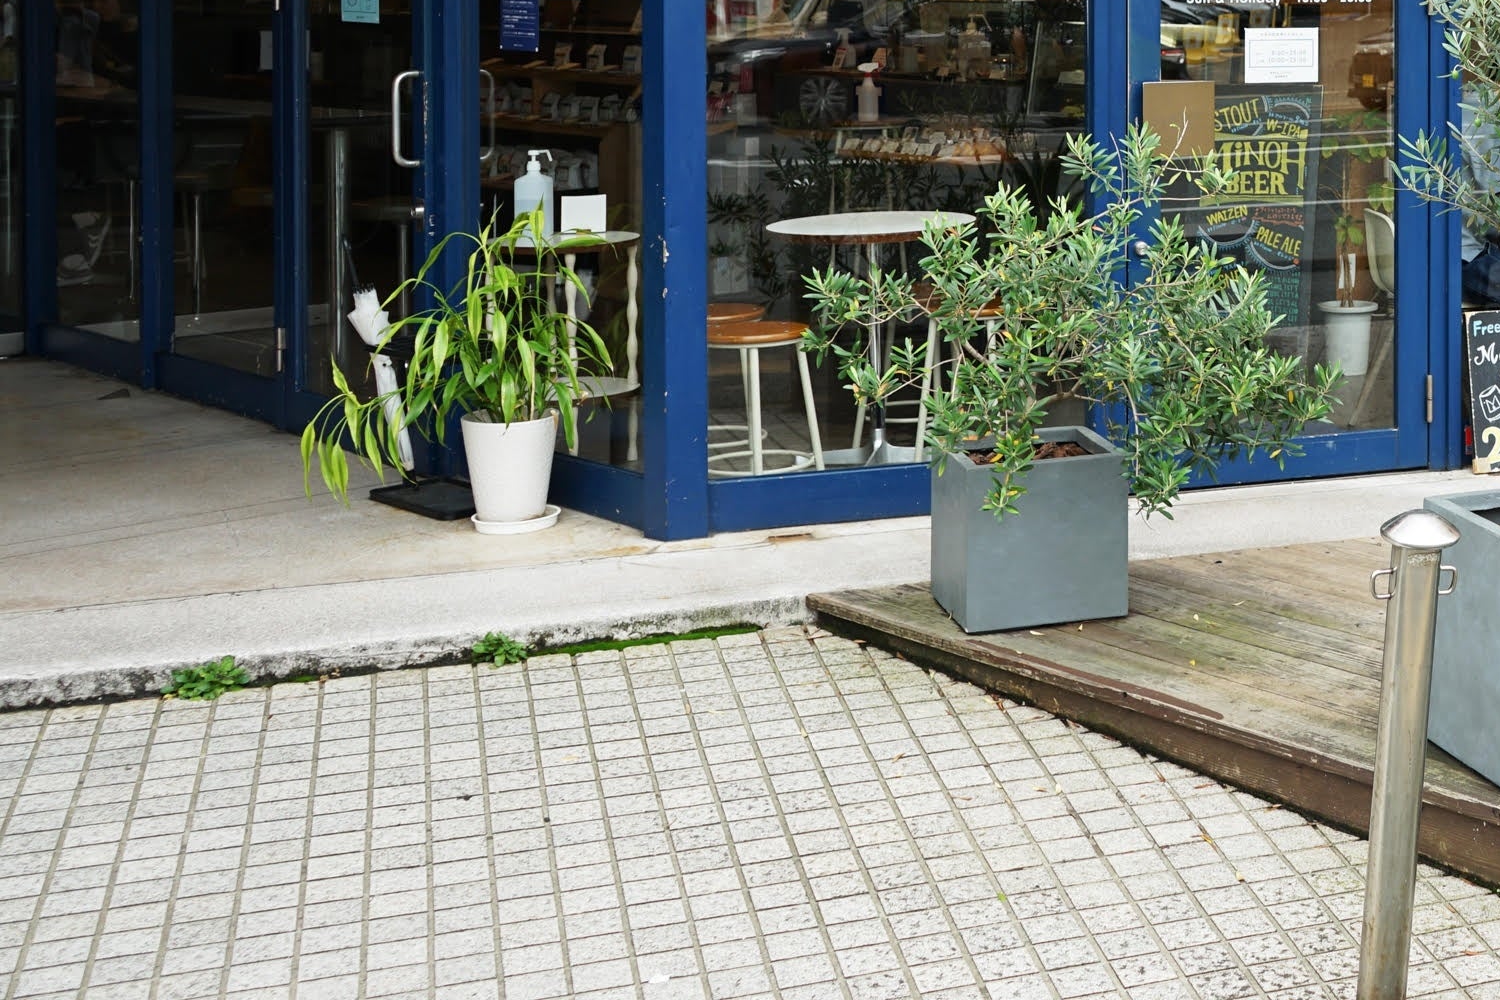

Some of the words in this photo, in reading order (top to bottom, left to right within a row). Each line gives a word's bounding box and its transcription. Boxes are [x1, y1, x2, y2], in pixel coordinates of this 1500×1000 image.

[1214, 98, 1260, 132] STOUT
[1266, 119, 1301, 138] W-IPA
[1225, 171, 1288, 195] BEER
[1206, 205, 1248, 225] WAIZEN
[1256, 226, 1282, 249] PALE
[1281, 237, 1302, 257] ALE
[1473, 320, 1500, 337] Free
